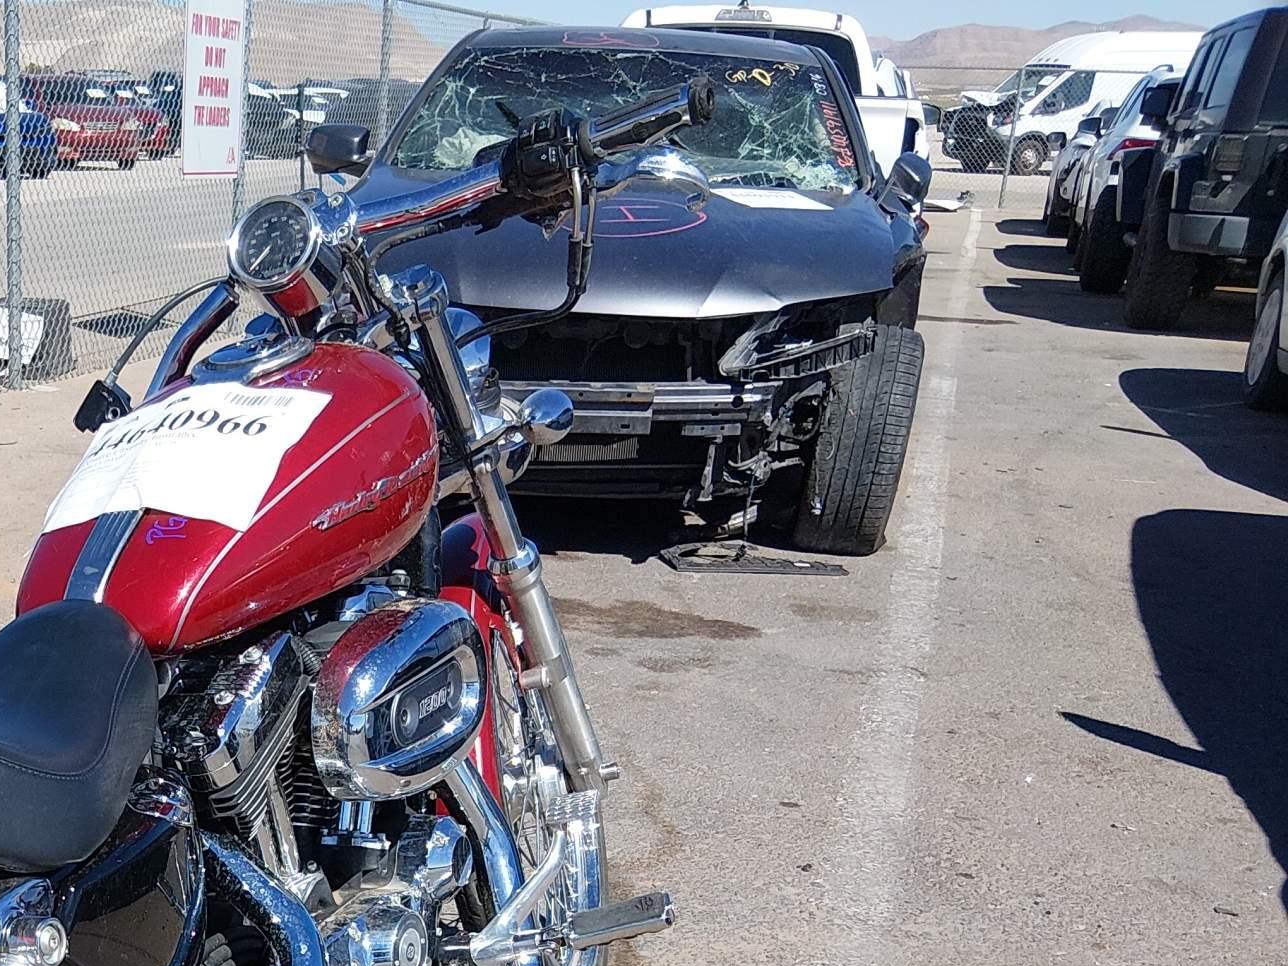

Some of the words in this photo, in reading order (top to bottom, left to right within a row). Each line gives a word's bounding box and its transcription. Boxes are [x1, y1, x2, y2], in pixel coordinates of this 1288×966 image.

[191, 13, 203, 35] FOR
[204, 15, 220, 38] YOUR
[221, 18, 241, 41] SAFETY
[205, 46, 214, 67] DO
[214, 47, 226, 69] NOT
[198, 75, 230, 98] APPROACH
[194, 105, 205, 126] THE
[205, 106, 231, 128] LOADERS
[418, 686, 447, 719] 1200
